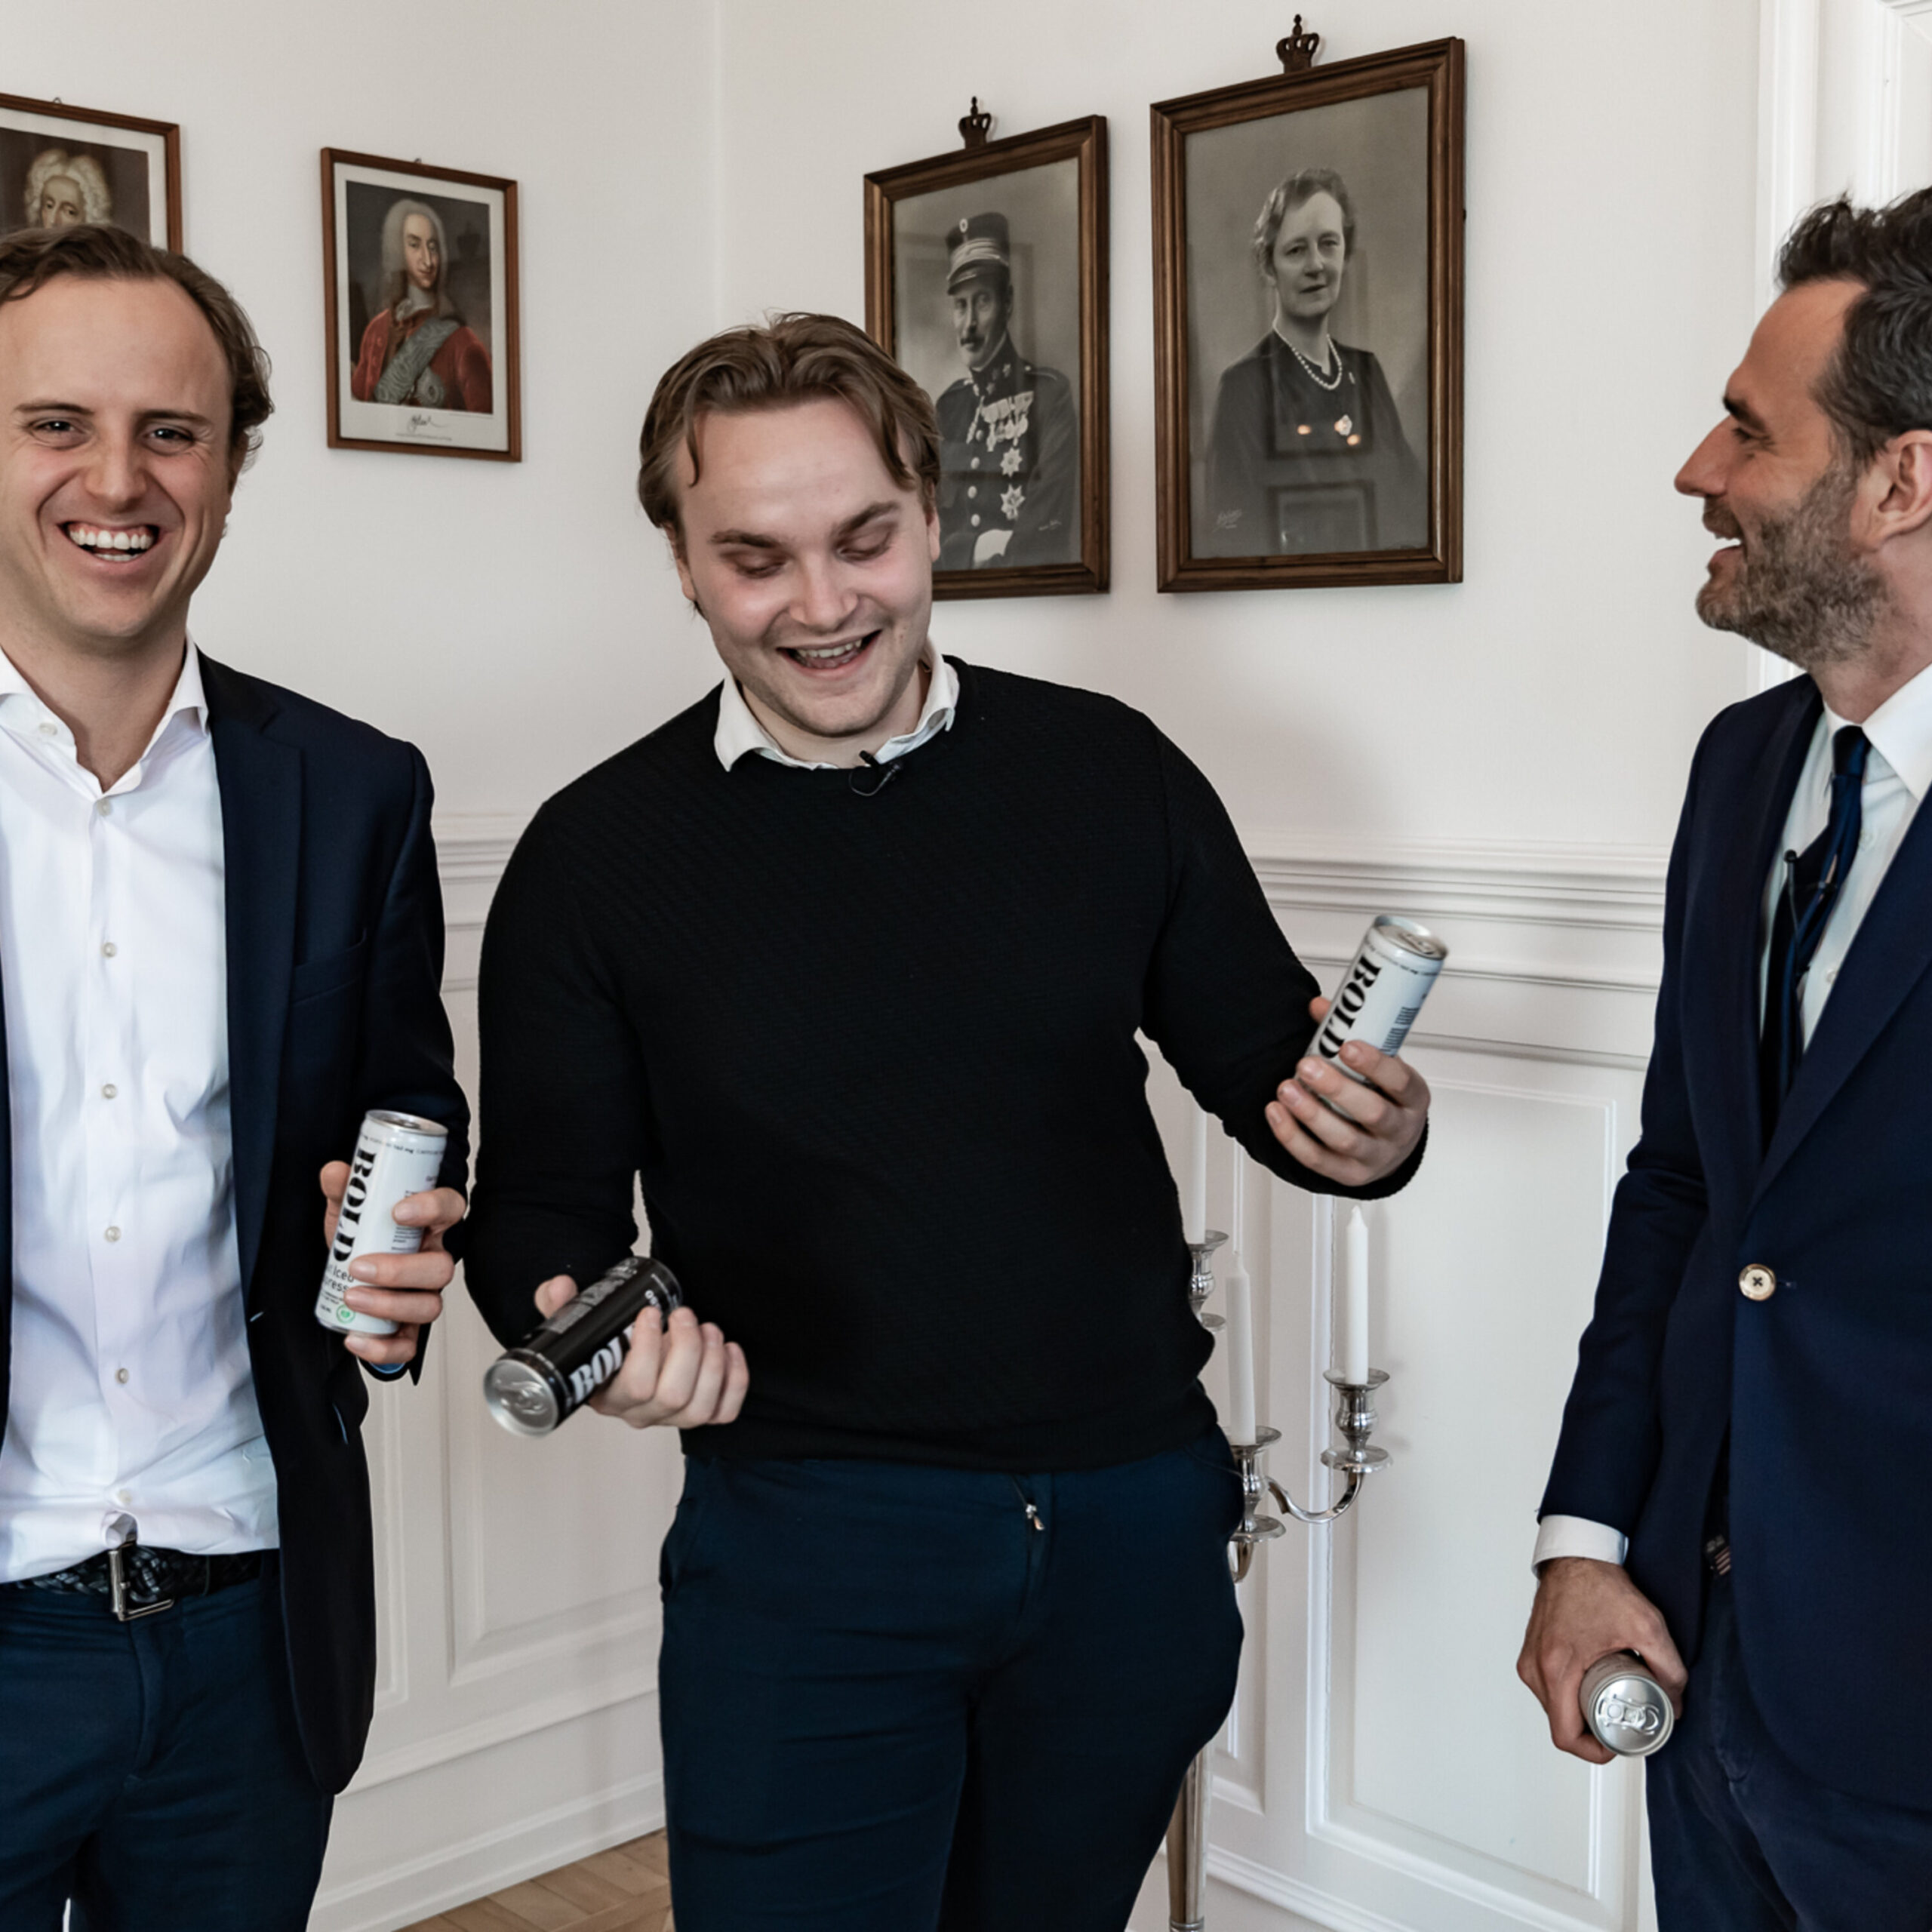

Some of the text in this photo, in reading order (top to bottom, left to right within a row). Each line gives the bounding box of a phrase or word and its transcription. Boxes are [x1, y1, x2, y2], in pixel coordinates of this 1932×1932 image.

[1318, 955, 1381, 1058] BOLD
[333, 1147, 377, 1262] BOLD
[569, 1324, 635, 1404] BOL
